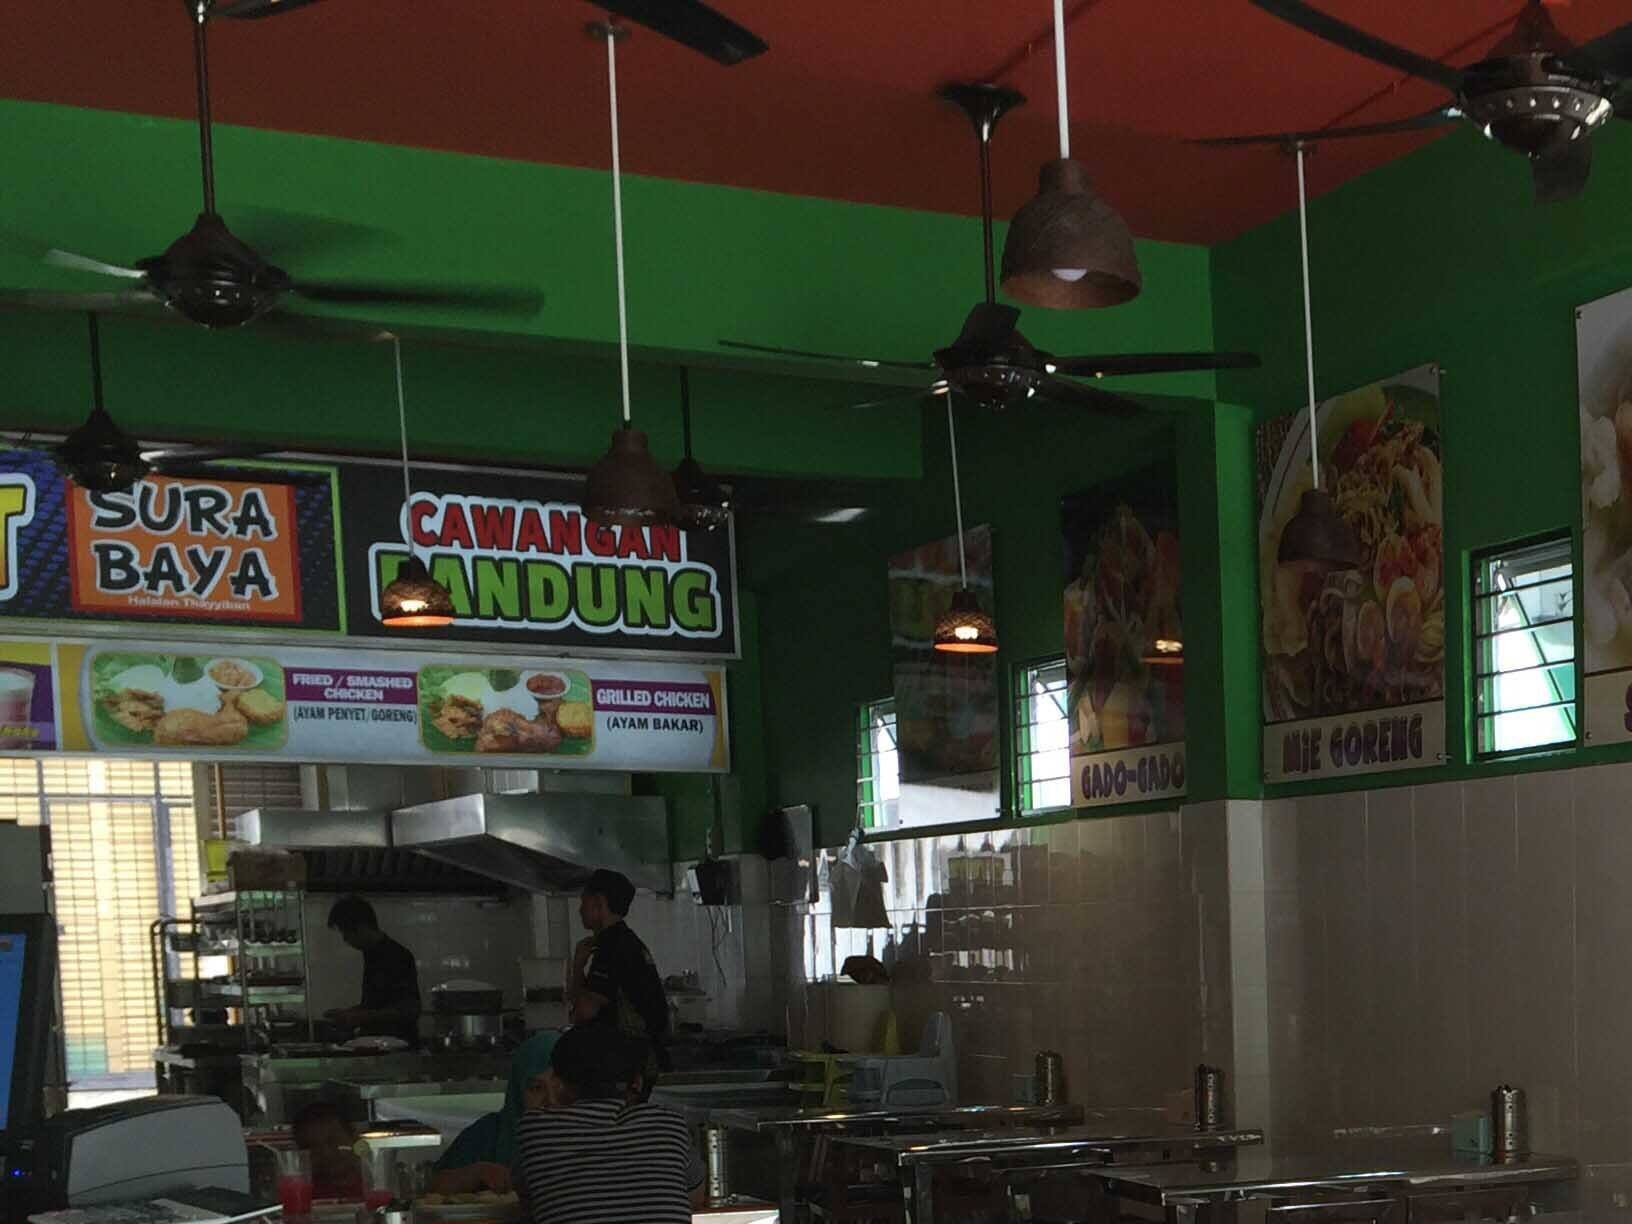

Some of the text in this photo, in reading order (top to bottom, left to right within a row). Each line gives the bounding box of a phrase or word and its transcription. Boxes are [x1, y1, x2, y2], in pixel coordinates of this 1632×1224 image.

[88, 484, 275, 539] SURA
[407, 498, 684, 564] CAWANGAN
[92, 541, 276, 598] BAYA
[376, 550, 718, 630] ANDUNG
[292, 673, 333, 685] FRIED
[346, 675, 413, 689] SMASHED
[324, 687, 384, 701] CHICKEN
[596, 688, 710, 709] GRILLED CHICKEN
[606, 716, 704, 735] (AYAM BAKAR)
[1330, 713, 1424, 768] GORENG
[1081, 751, 1185, 800] GADO-GADO
